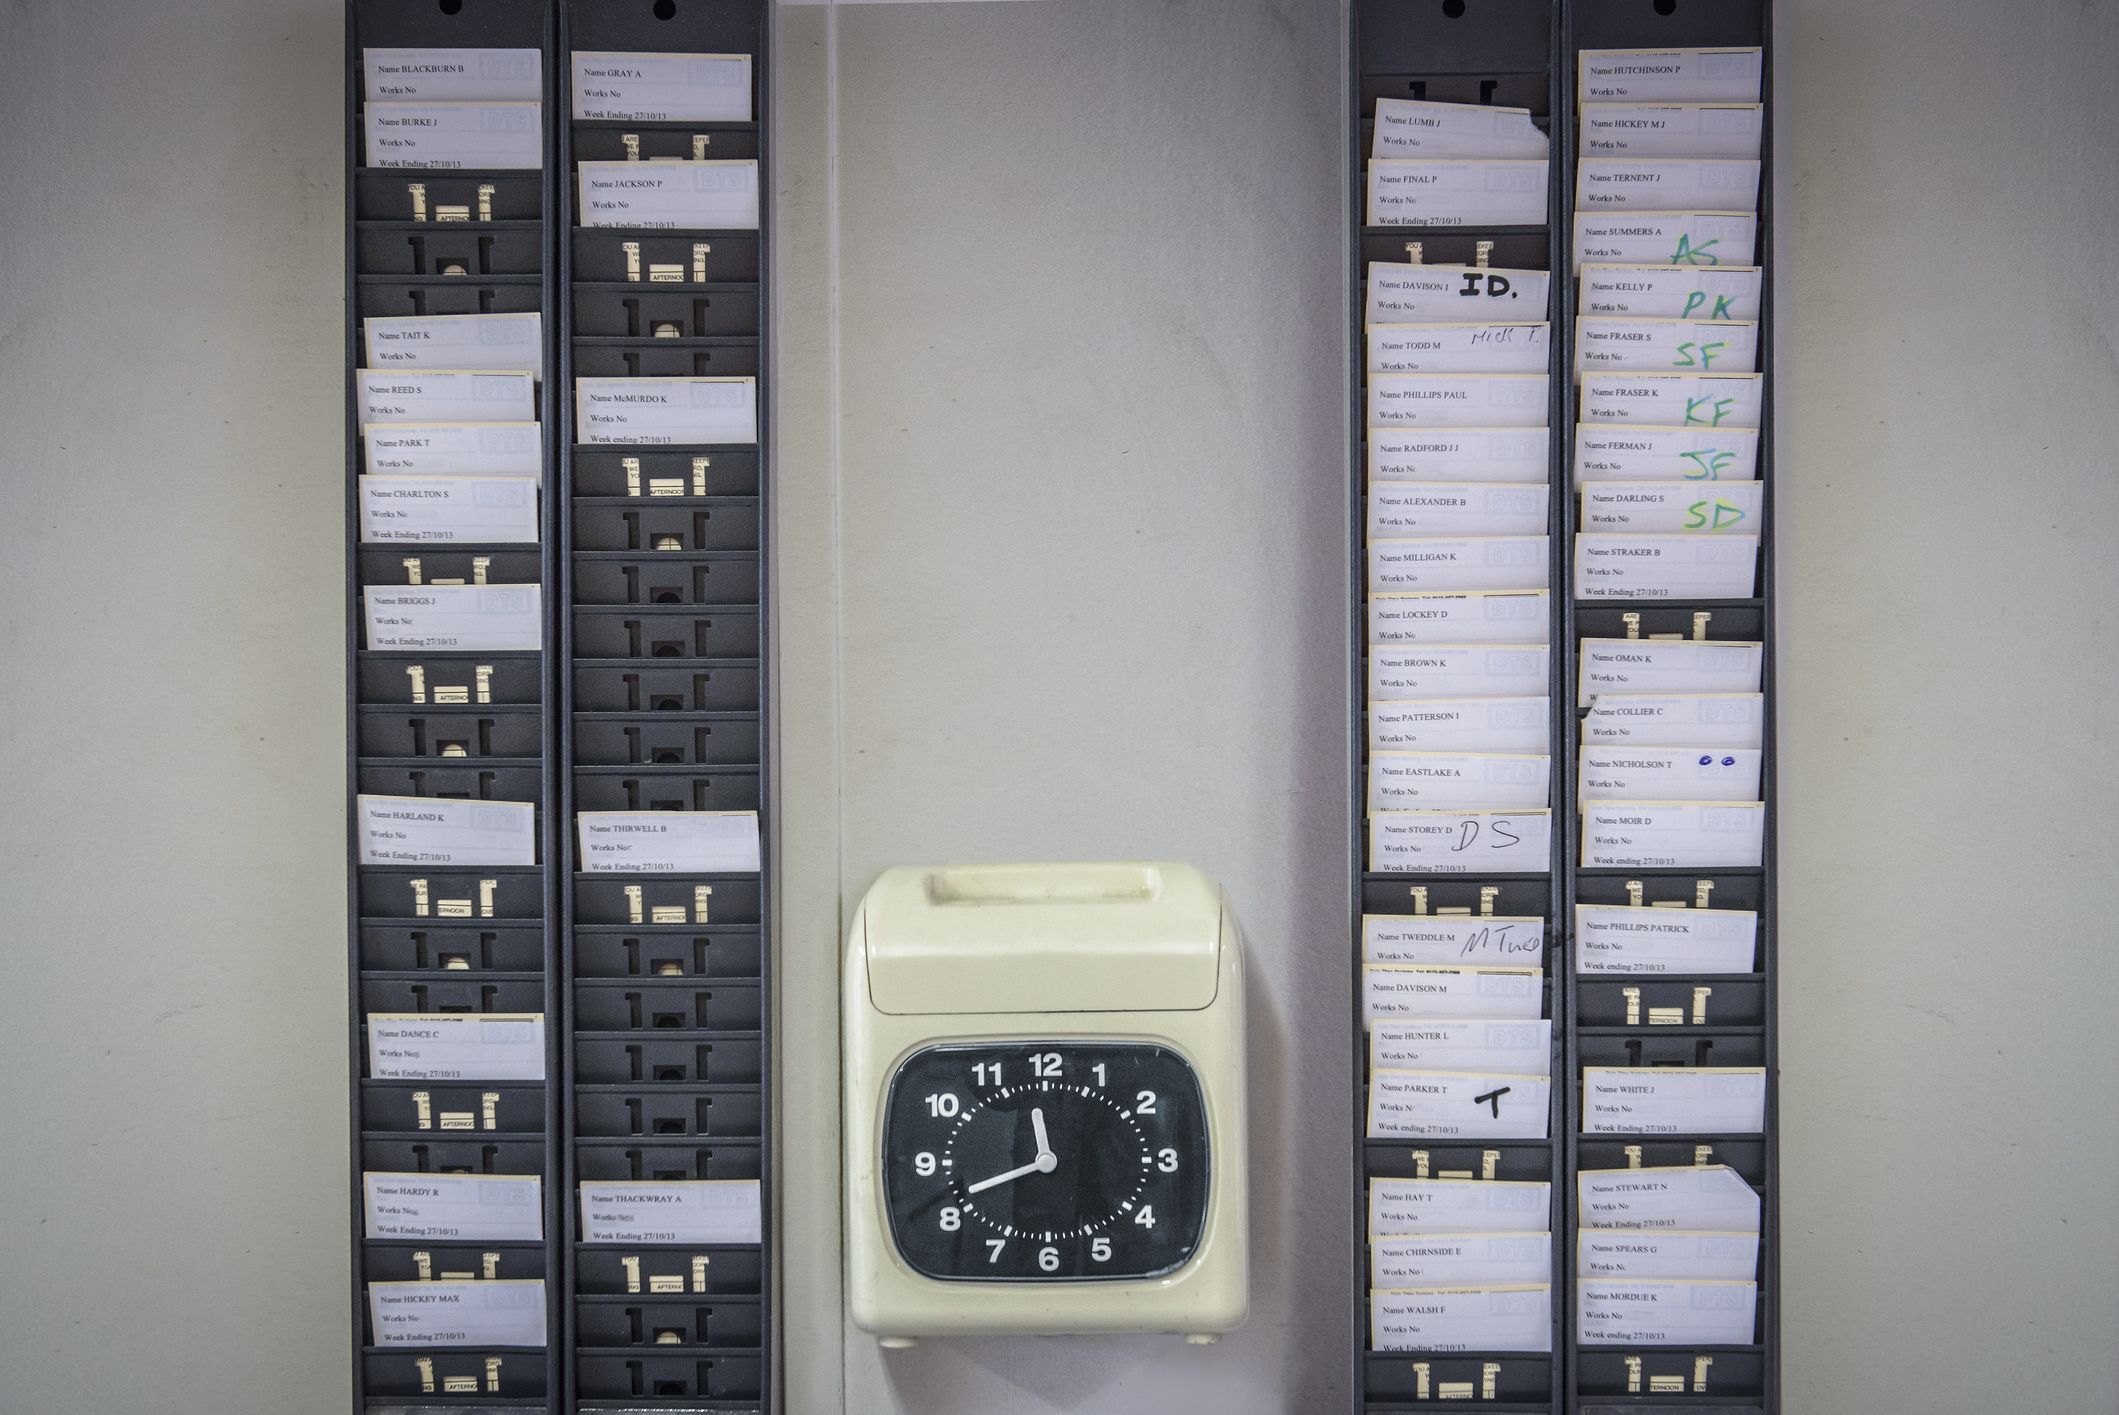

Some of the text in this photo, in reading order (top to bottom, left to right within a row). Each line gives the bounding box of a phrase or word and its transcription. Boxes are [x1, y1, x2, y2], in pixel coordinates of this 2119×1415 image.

[378, 65, 400, 74] Name
[401, 64, 456, 74] BLACKBURN
[584, 67, 606, 77] Name
[607, 69, 633, 78] GRAY
[1590, 67, 1613, 76] Name
[1614, 65, 1674, 75] HUTCHINSON
[378, 86, 417, 95] Works No
[583, 88, 622, 98] Works No
[378, 117, 400, 126] Name
[401, 118, 432, 127] BURKE
[1590, 119, 1614, 128] Name
[1614, 119, 1649, 129] HICKEY
[1589, 140, 1628, 149] Works No
[591, 180, 614, 188] Name
[614, 179, 655, 188] JACKSON
[1379, 175, 1402, 184] Name
[1403, 175, 1430, 184] FINAL
[1378, 216, 1463, 226] Week Ending 27/10/13
[1585, 227, 1608, 236] Name
[1608, 227, 1654, 236] SUMMERS
[1670, 233, 1719, 266] AS
[1378, 279, 1401, 289] Name
[1402, 281, 1444, 292] DAVISON
[1460, 273, 1518, 299] ID.
[1590, 282, 1614, 291] Name
[1615, 282, 1646, 292] KELLY
[1381, 342, 1404, 350] Name
[1405, 341, 1431, 350] TODD
[1672, 342, 1725, 370] SF
[590, 393, 612, 402] Name
[613, 394, 660, 403] McMURDO
[1379, 390, 1468, 400] Name PHILLIPS PAUL
[1378, 410, 1417, 420] Works No
[1584, 441, 1608, 450] Name
[1608, 441, 1646, 451] FERMAN
[1680, 448, 1736, 481] JF
[370, 489, 392, 498] Name
[393, 490, 442, 499] CHARLTON
[1592, 494, 1615, 503] Name
[1616, 494, 1658, 503] DARLING
[1379, 496, 1402, 505] Name
[1402, 497, 1458, 506] ALEXANDER
[1684, 500, 1745, 529] SD
[1587, 547, 1610, 556] Name
[1610, 548, 1653, 557] STRAKER
[1379, 554, 1402, 563] Name
[1403, 553, 1448, 562] MILLIGAN
[1586, 567, 1624, 576] Works No
[1584, 587, 1669, 598] Week Ending 27/10/13
[1377, 610, 1401, 620] Name
[1402, 610, 1439, 619] LOCKEY
[1380, 658, 1403, 667] Name
[1404, 659, 1438, 667] BROWN
[1588, 759, 1611, 768] Name
[1612, 760, 1665, 769] NICHOLSON
[370, 810, 392, 819] Name
[392, 811, 437, 822] HARLAND
[1384, 825, 1408, 834] Name
[1408, 826, 1444, 834] STOREY
[1594, 836, 1632, 845] Works No
[1586, 921, 1690, 934] Name PHILLIPS PATRICK
[1377, 932, 1400, 941] Name
[1401, 933, 1445, 942] TWEDDLE
[1583, 961, 1666, 973] Week ending 27/10/13
[1372, 983, 1395, 992] Name
[1396, 984, 1437, 993] DAVISON
[1029, 1053, 1062, 1076] 12
[972, 1063, 1001, 1086] 11
[1092, 1063, 1105, 1086] 1
[925, 1093, 959, 1117] 10
[1136, 1091, 1156, 1114] 2
[915, 1152, 936, 1176] 9
[1158, 1148, 1178, 1172] 3
[591, 1194, 614, 1203] Name
[614, 1194, 673, 1203] THACKWRAY
[939, 1207, 960, 1231] 8
[1135, 1205, 1155, 1228] 4
[986, 1239, 1006, 1263] 7
[1091, 1238, 1111, 1261] 5
[1382, 1248, 1404, 1257] Name
[1405, 1248, 1454, 1256] CHIRNSIDE
[1039, 1247, 1059, 1271] 6
[380, 1294, 460, 1304] Name HICKEY MAX
[1586, 1291, 1609, 1300] Name
[1610, 1292, 1649, 1302] MORDUE
[1585, 1311, 1623, 1320] Works No
[383, 1332, 466, 1343] Week Ending 27/10/13
[1584, 1330, 1666, 1341] Week ending 27/10/13
